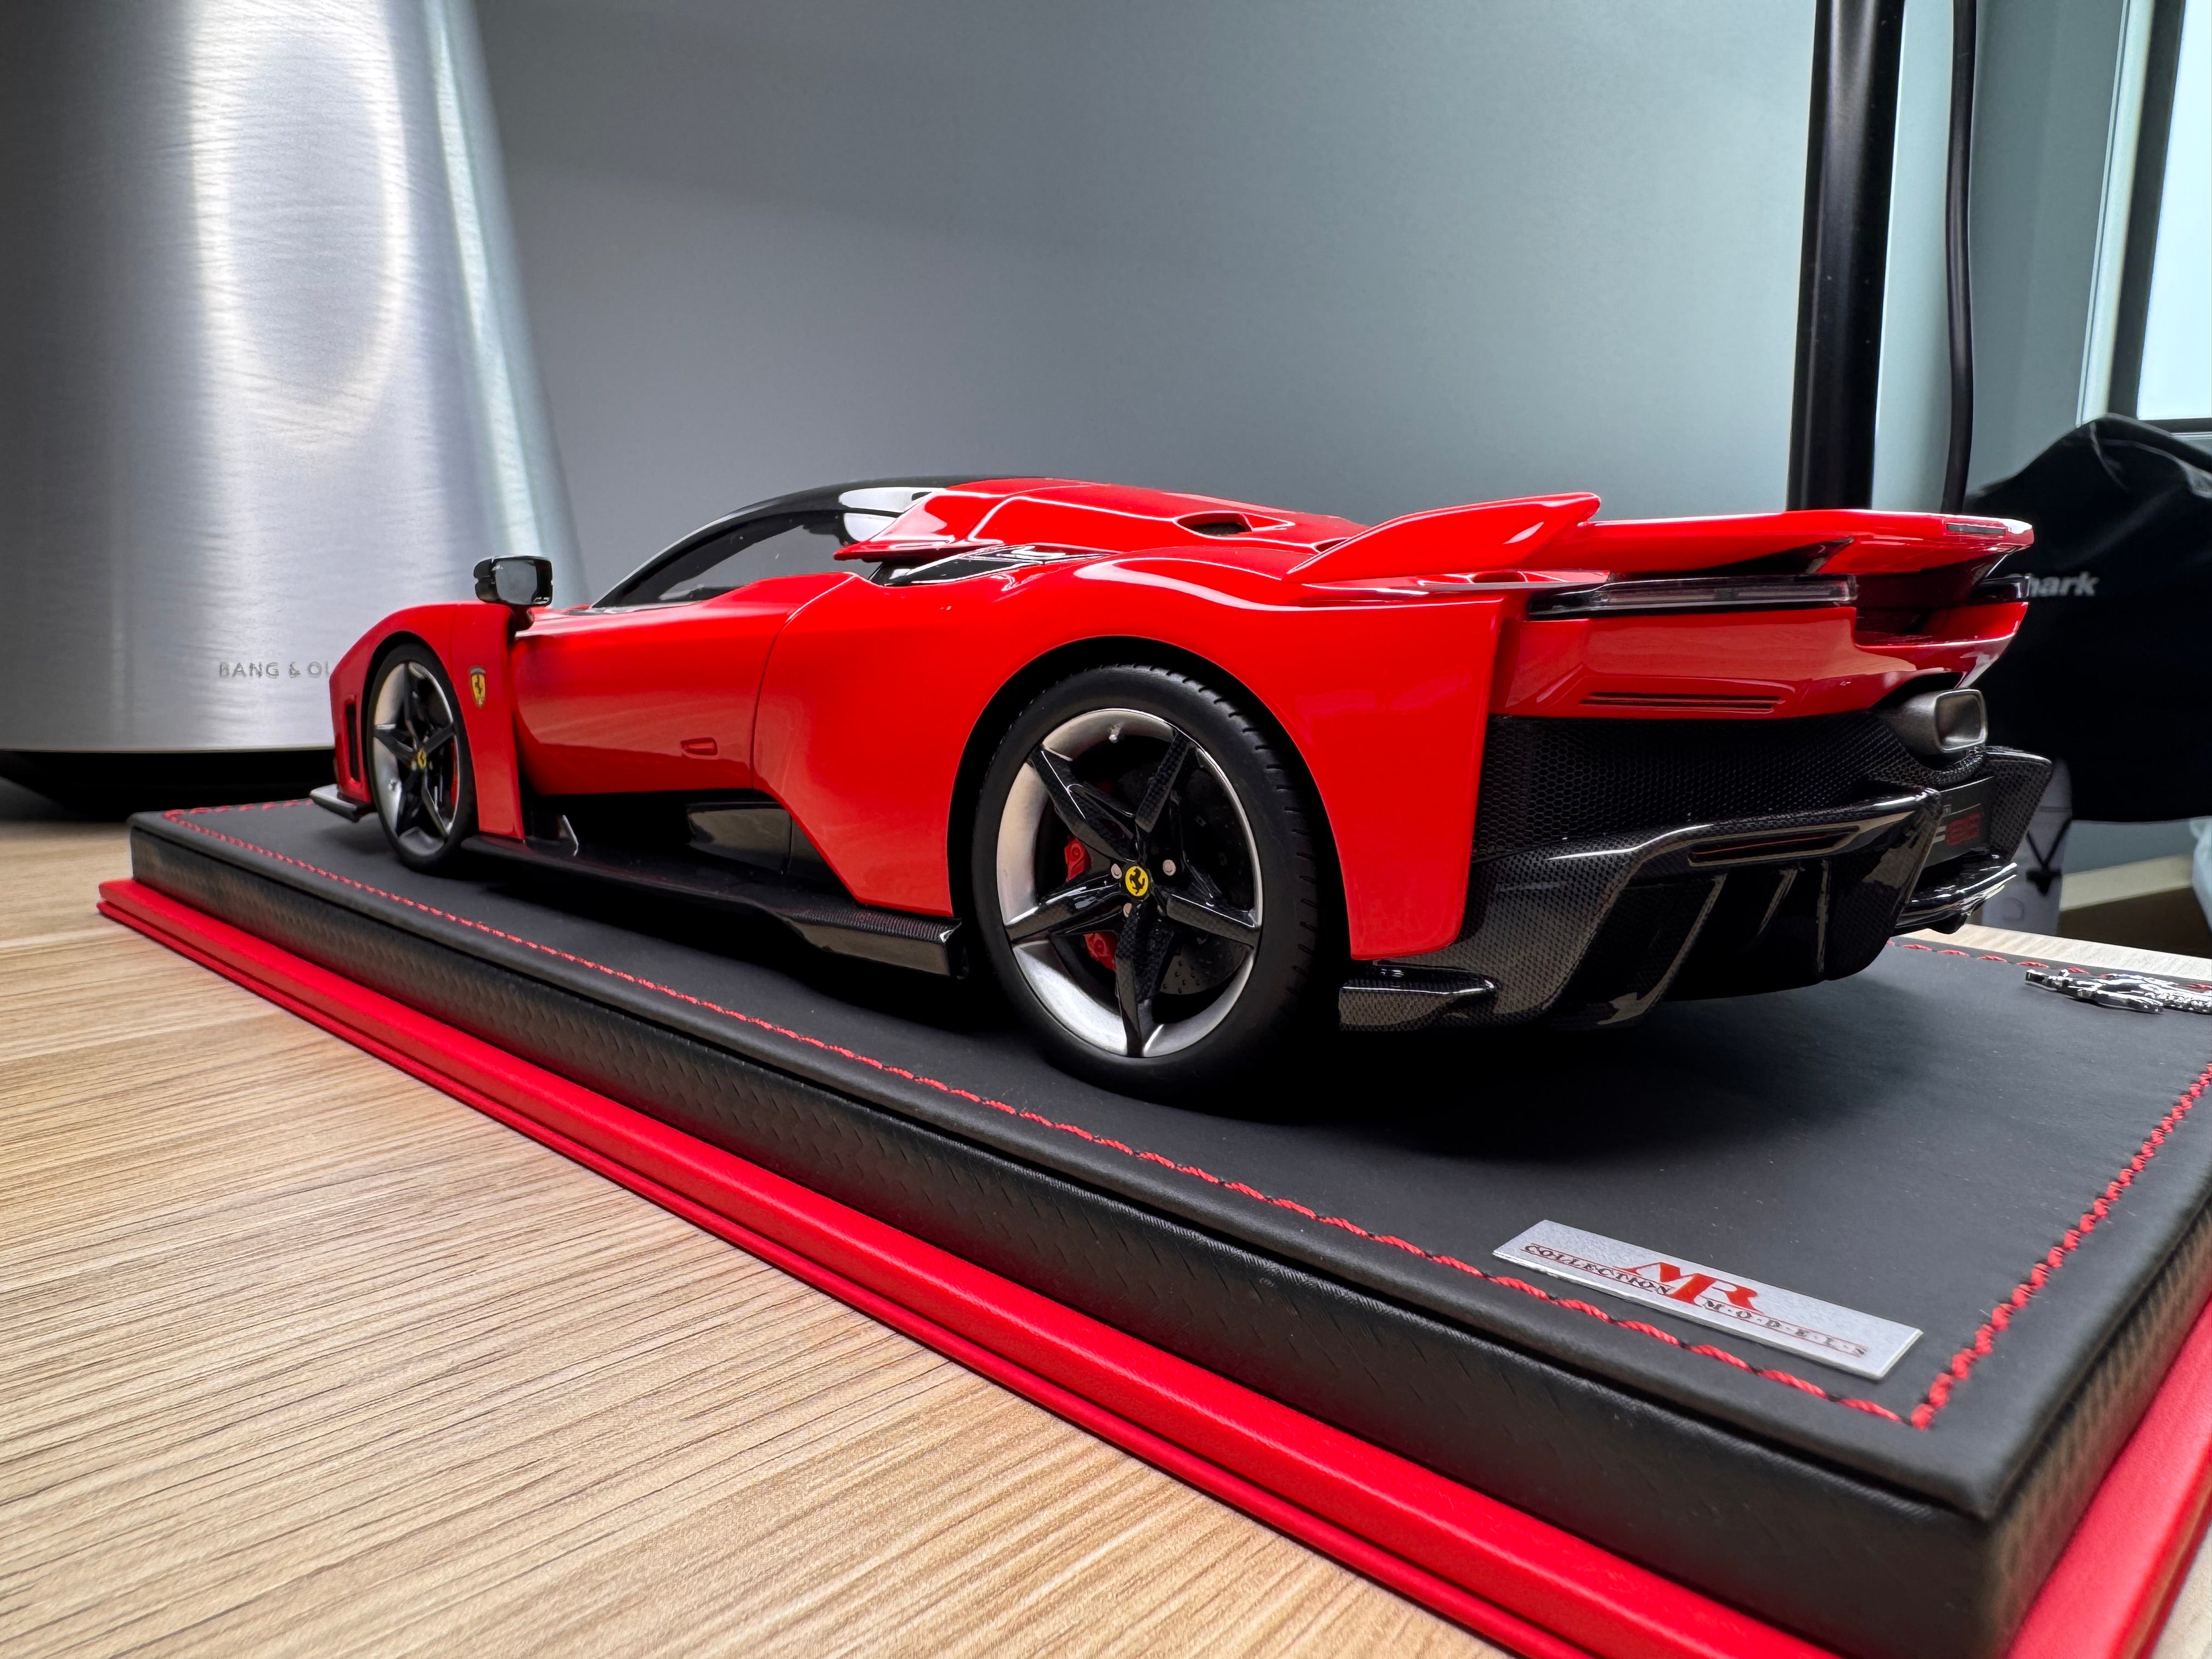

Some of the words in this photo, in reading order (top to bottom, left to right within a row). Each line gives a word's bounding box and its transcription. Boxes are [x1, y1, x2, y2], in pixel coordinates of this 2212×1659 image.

[2008, 572, 2100, 597] hark
[219, 662, 279, 679] BANG
[288, 661, 301, 678] &
[1525, 1244, 1671, 1295] COLLECTION
[1614, 1262, 1763, 1313] MR
